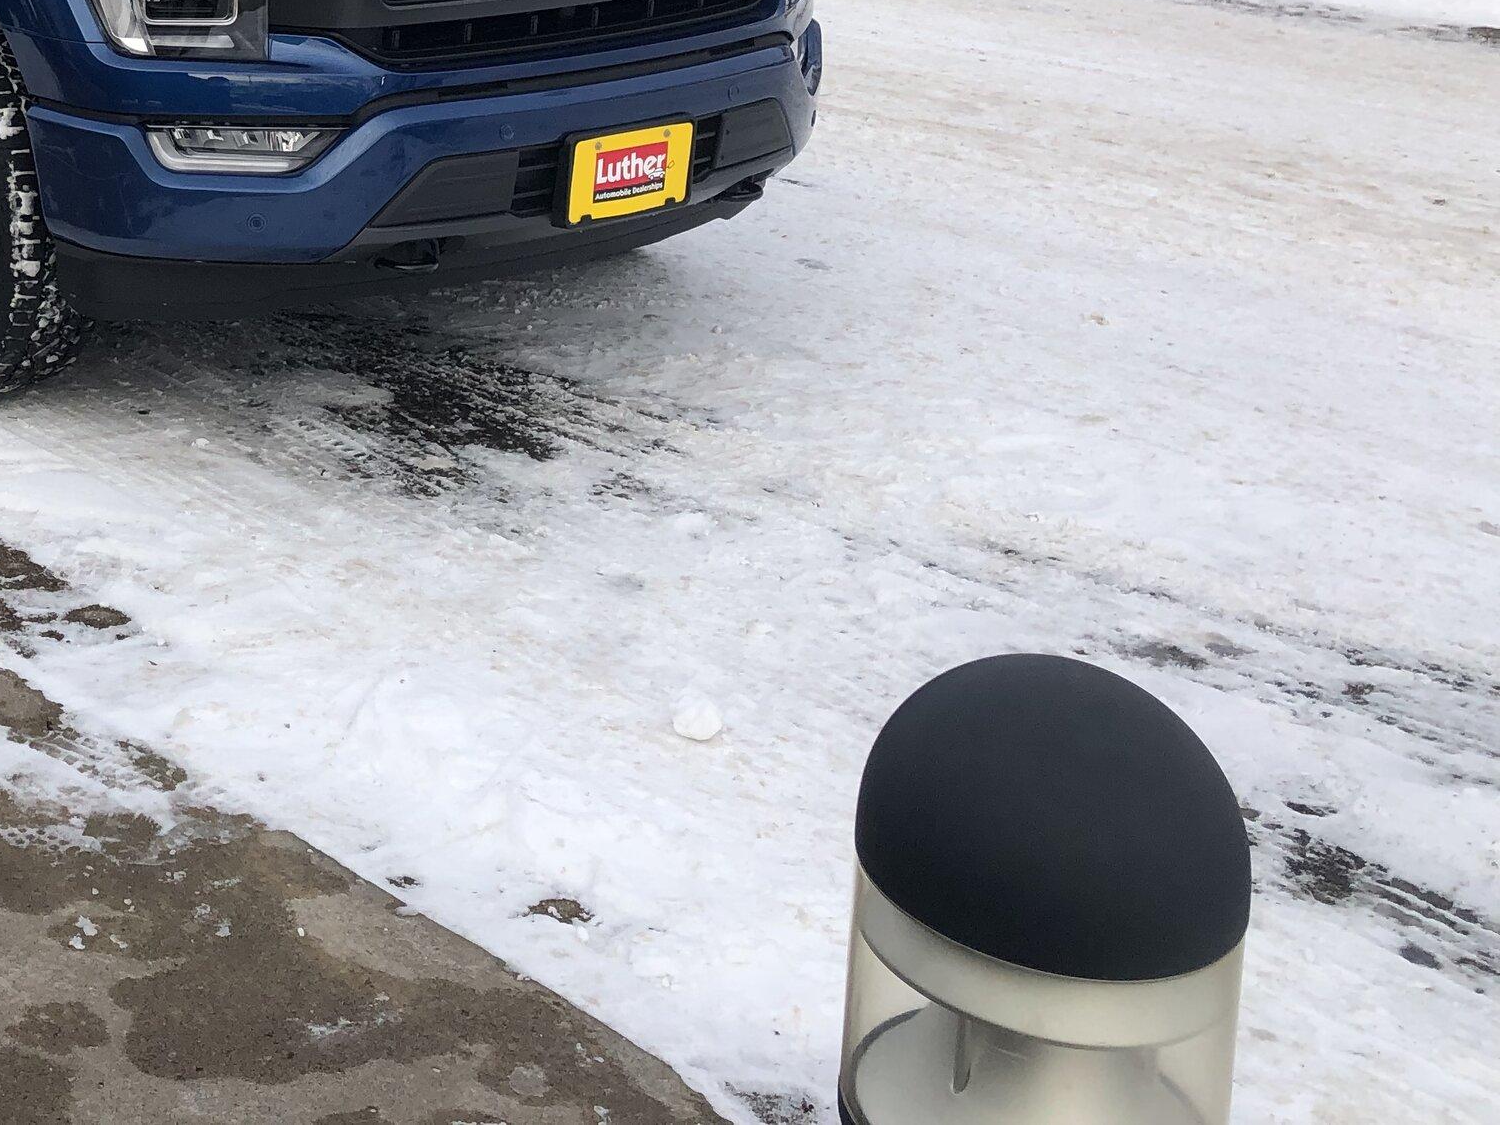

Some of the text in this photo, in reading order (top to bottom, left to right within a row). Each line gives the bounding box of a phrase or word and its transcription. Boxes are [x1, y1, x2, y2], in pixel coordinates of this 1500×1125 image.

[596, 152, 666, 185] Luther
[595, 181, 663, 201] Automobile Dealerships
